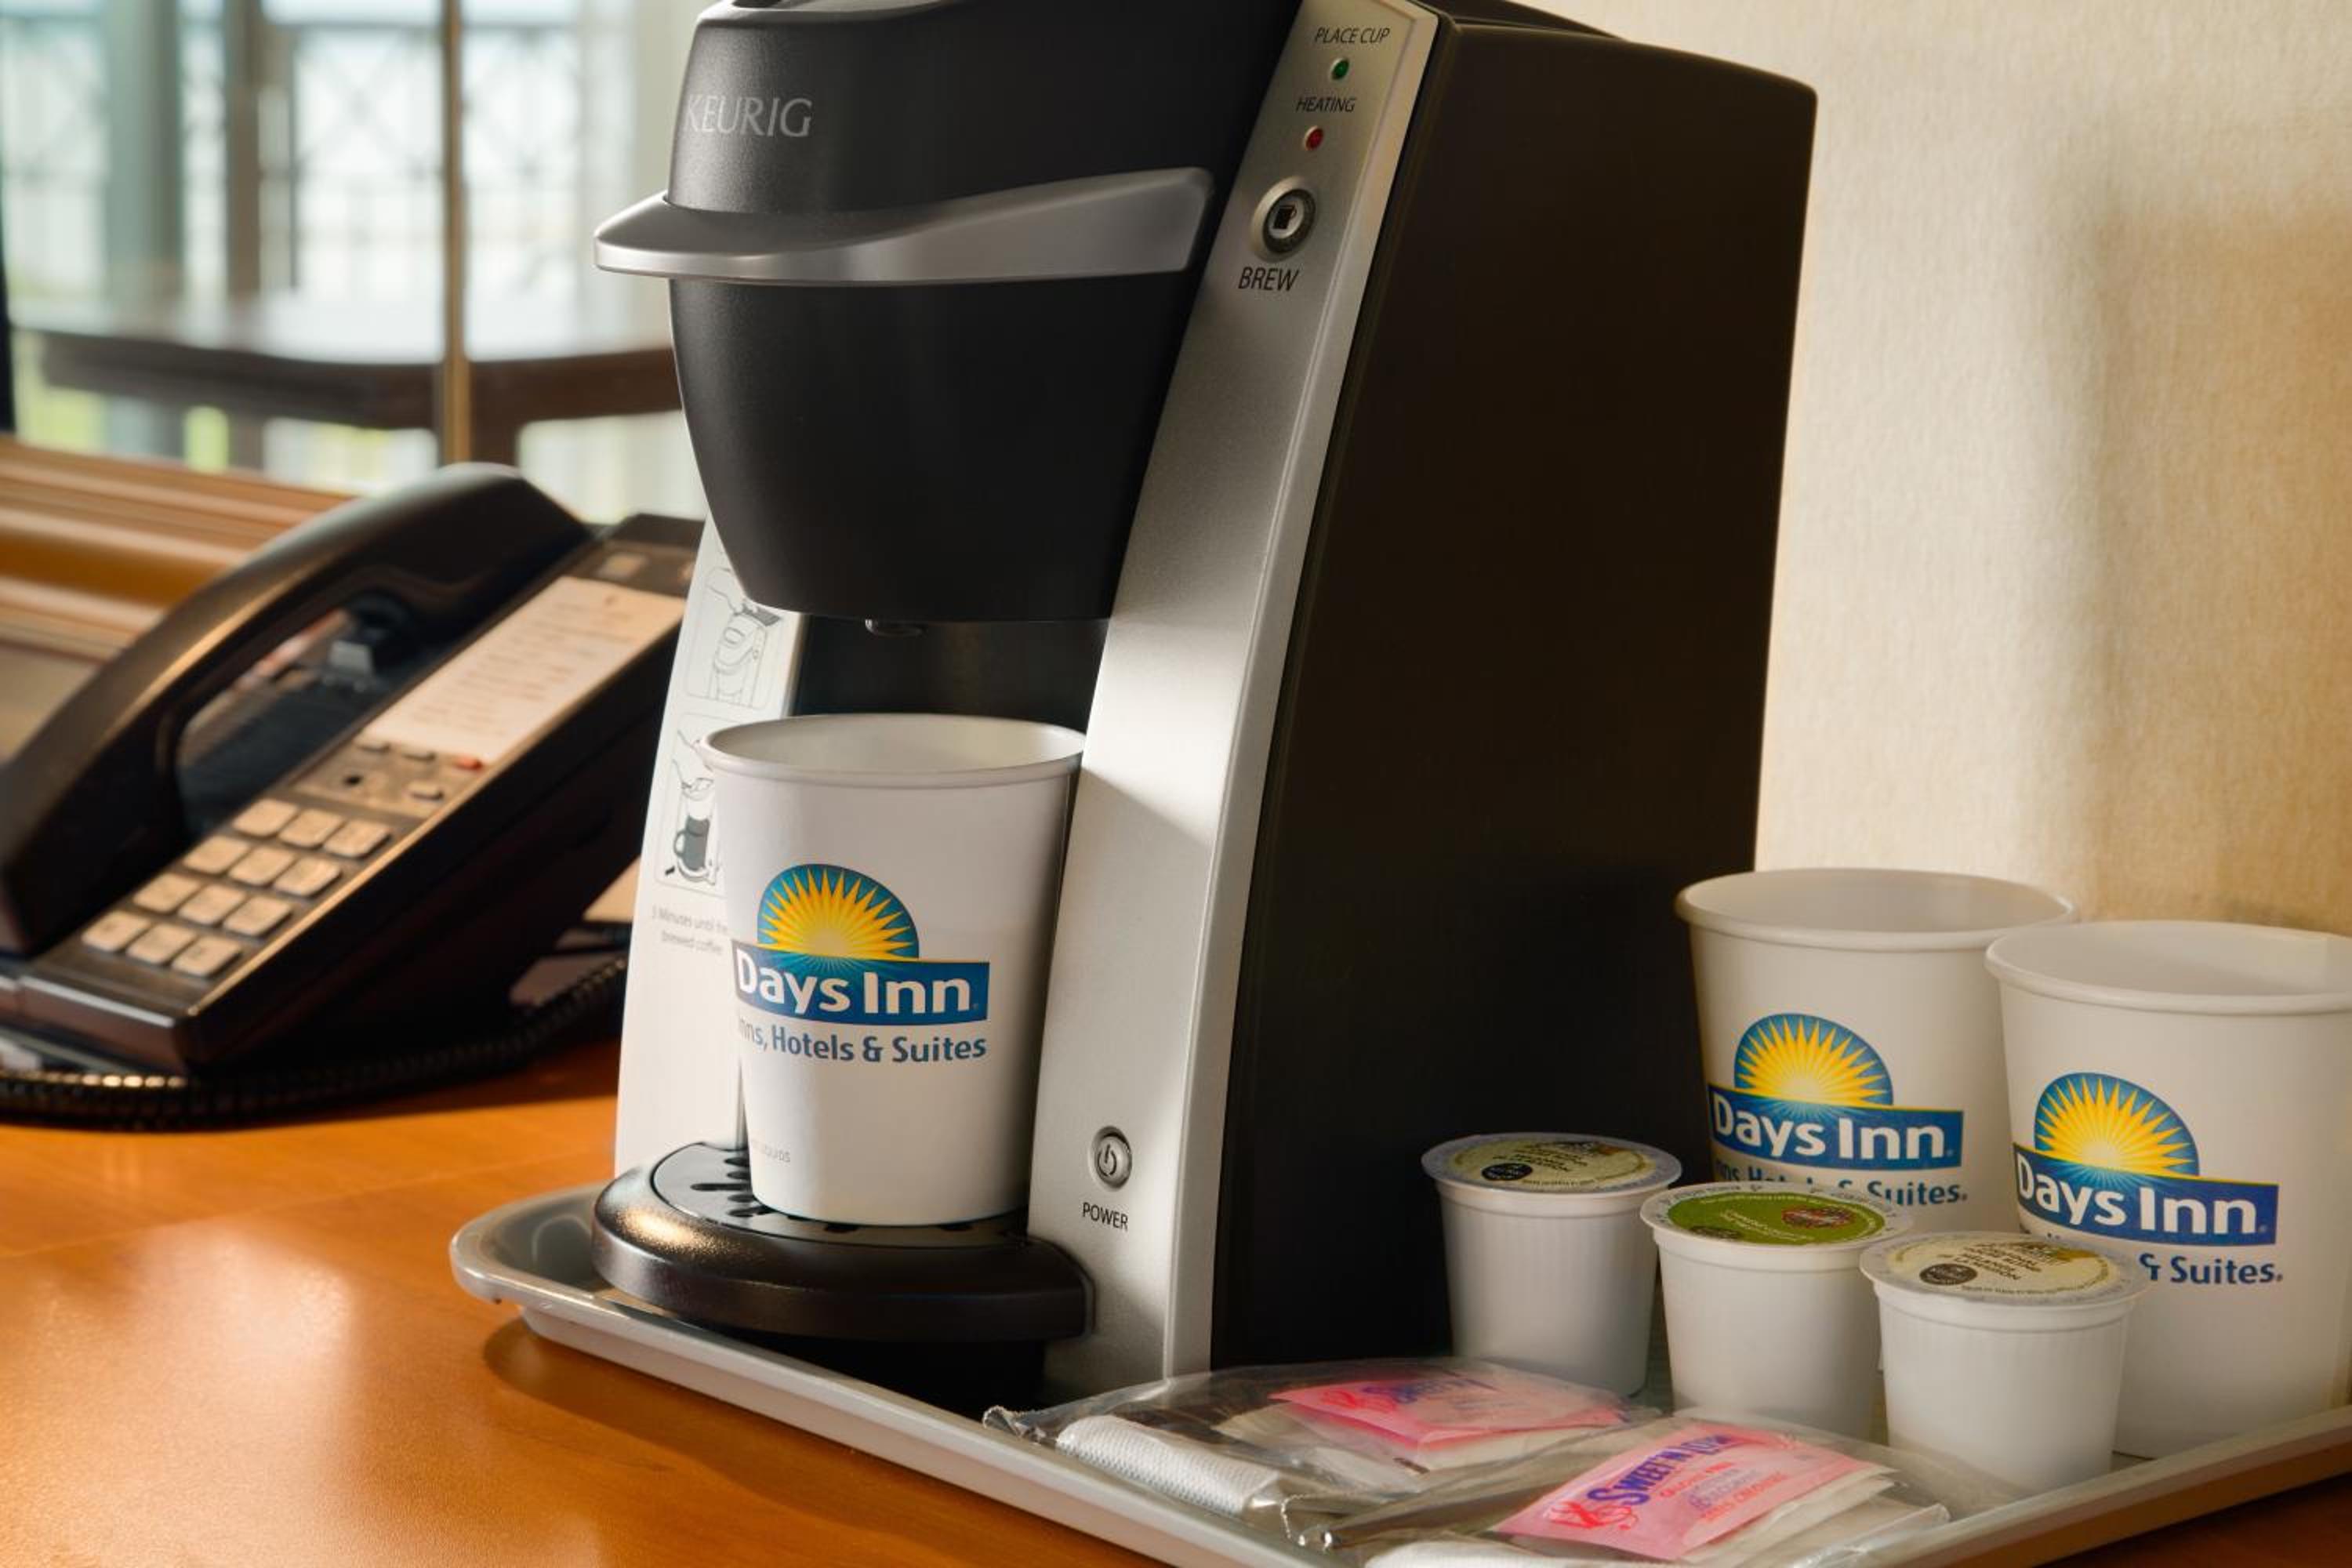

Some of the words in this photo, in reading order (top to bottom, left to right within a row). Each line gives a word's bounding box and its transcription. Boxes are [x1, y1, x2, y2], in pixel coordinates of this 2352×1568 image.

[1315, 27, 1358, 43] PLACE
[1360, 27, 1390, 43] CUP
[686, 93, 812, 137] KEURIG
[1296, 96, 1356, 112] HEATING
[1239, 267, 1299, 291] BREW
[736, 949, 851, 1014] Days
[864, 971, 970, 1014] Inn
[771, 1023, 854, 1061] Hotels
[862, 1035, 883, 1062] &
[892, 1036, 986, 1062] Suites
[1713, 1093, 1826, 1156] Days
[1838, 1118, 1944, 1160] Inn
[2016, 1153, 2126, 1225] Days
[2140, 1187, 2256, 1234] Inn
[1083, 1202, 1128, 1231] POWER
